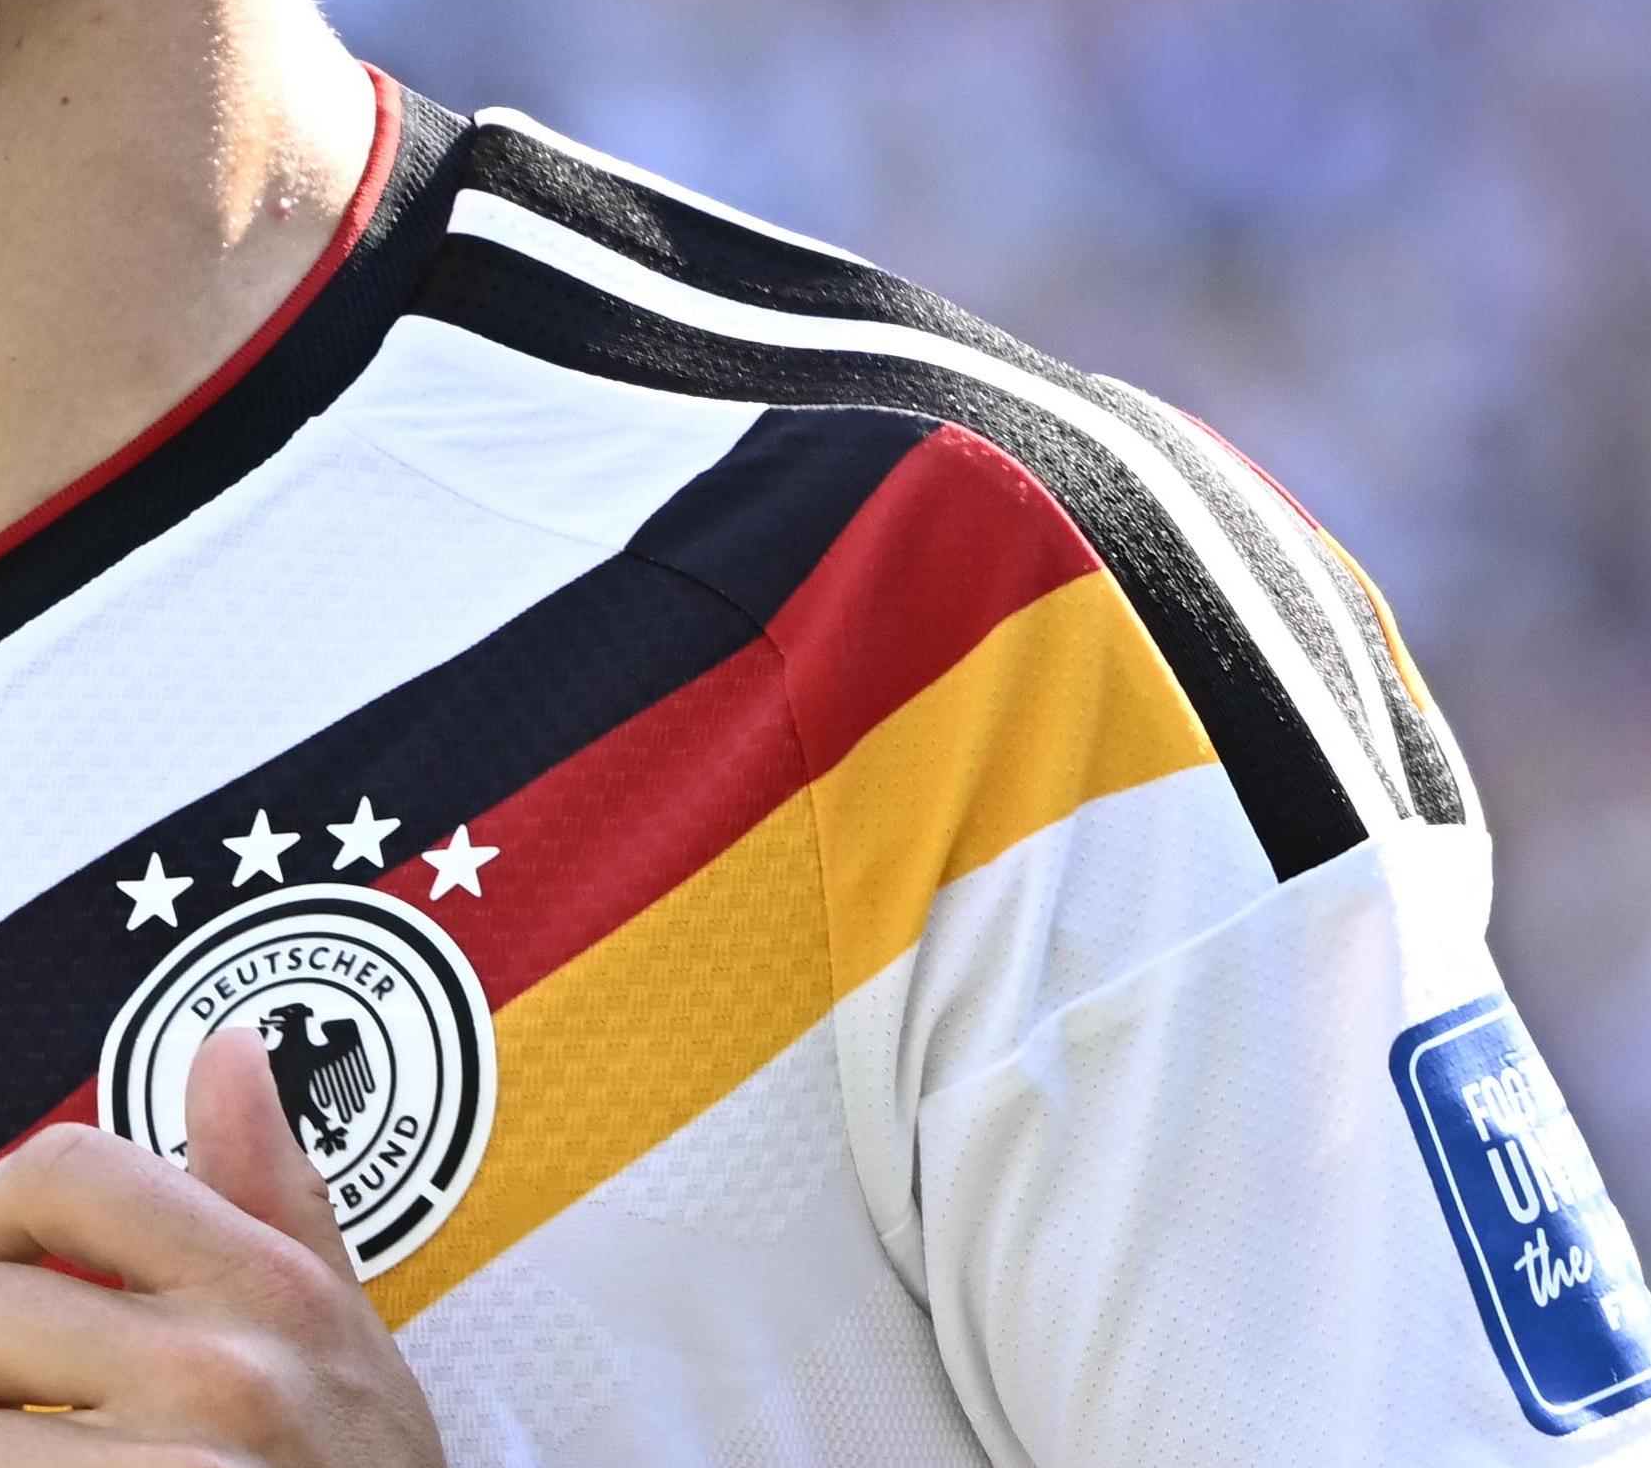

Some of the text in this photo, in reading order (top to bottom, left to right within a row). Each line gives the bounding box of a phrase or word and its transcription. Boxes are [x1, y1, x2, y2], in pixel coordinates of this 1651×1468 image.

[190, 946, 396, 1022] DEUTSCHER
[333, 1115, 419, 1209] BUND
[1514, 1227, 1594, 1308] the
